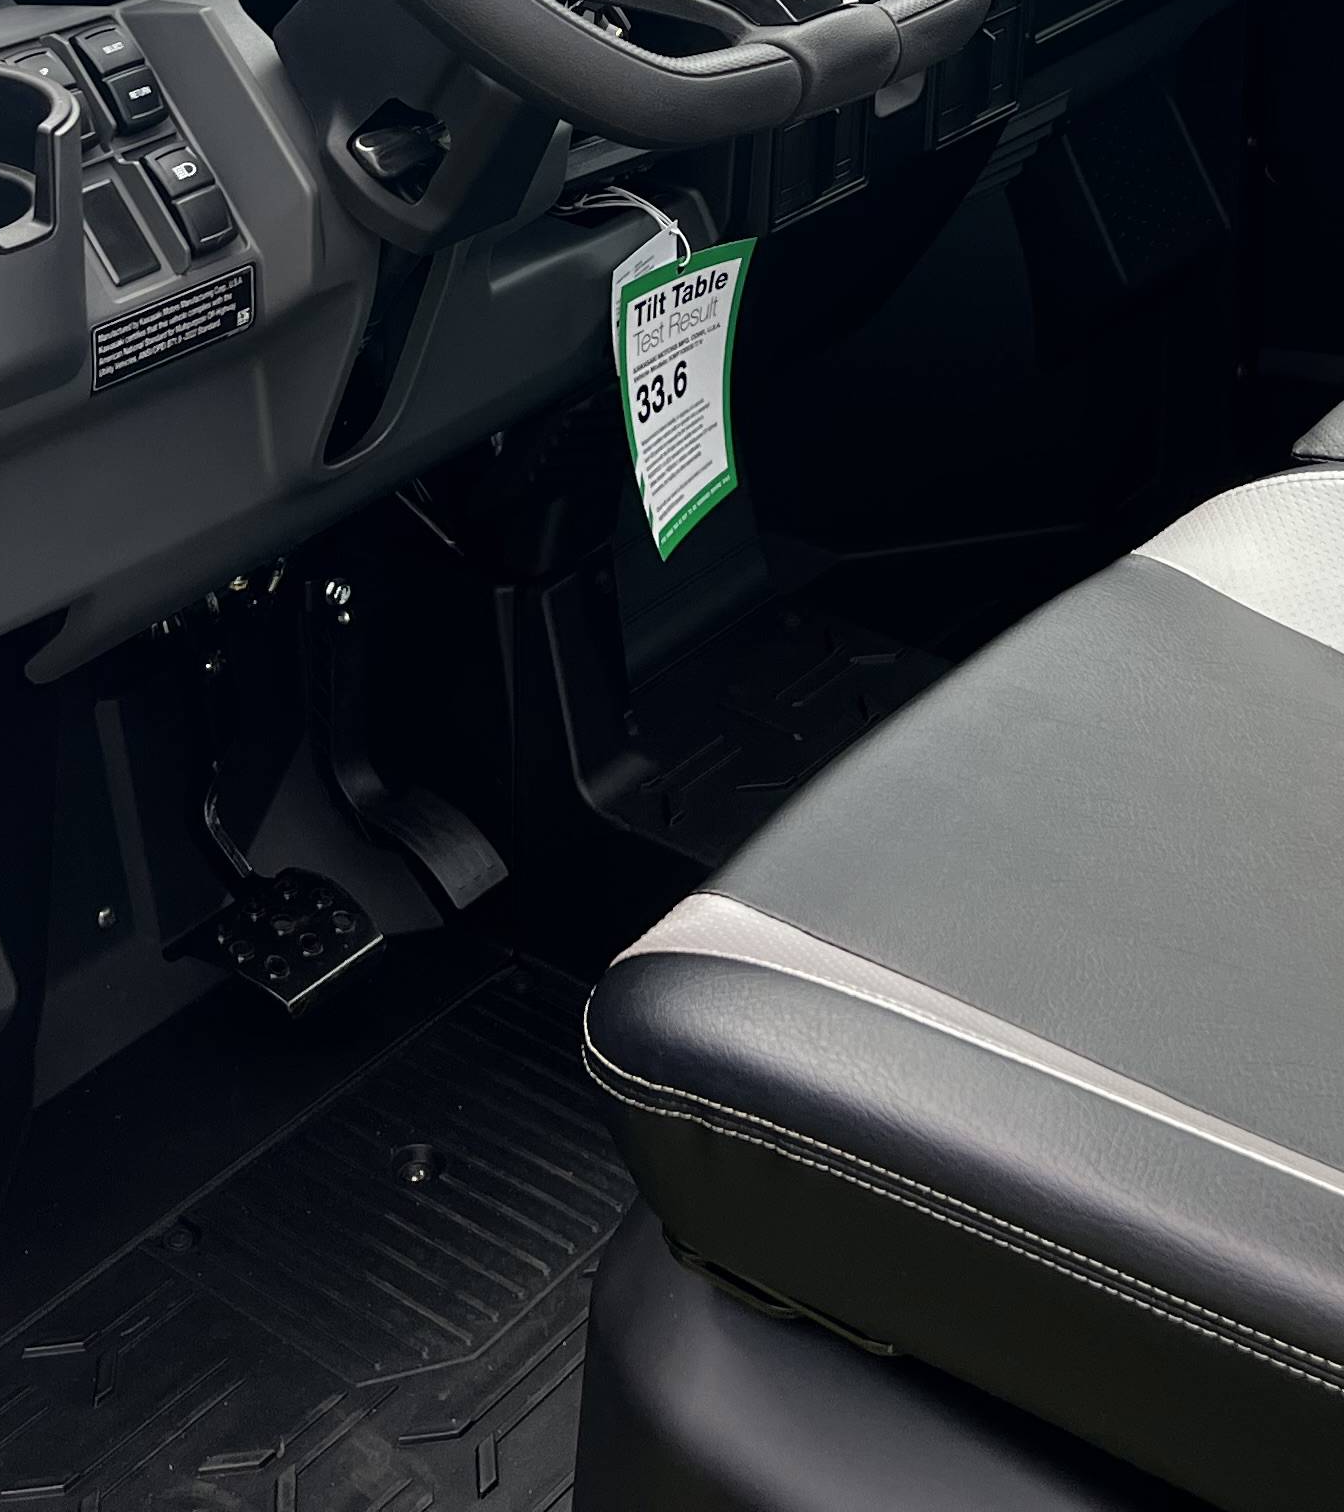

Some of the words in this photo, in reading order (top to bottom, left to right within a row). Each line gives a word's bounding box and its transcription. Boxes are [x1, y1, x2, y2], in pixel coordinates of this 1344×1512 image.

[633, 321, 664, 356] Test
[669, 296, 718, 338] Result
[634, 292, 667, 327] Tilt
[672, 270, 728, 308] Table
[635, 359, 689, 424] 33.6
